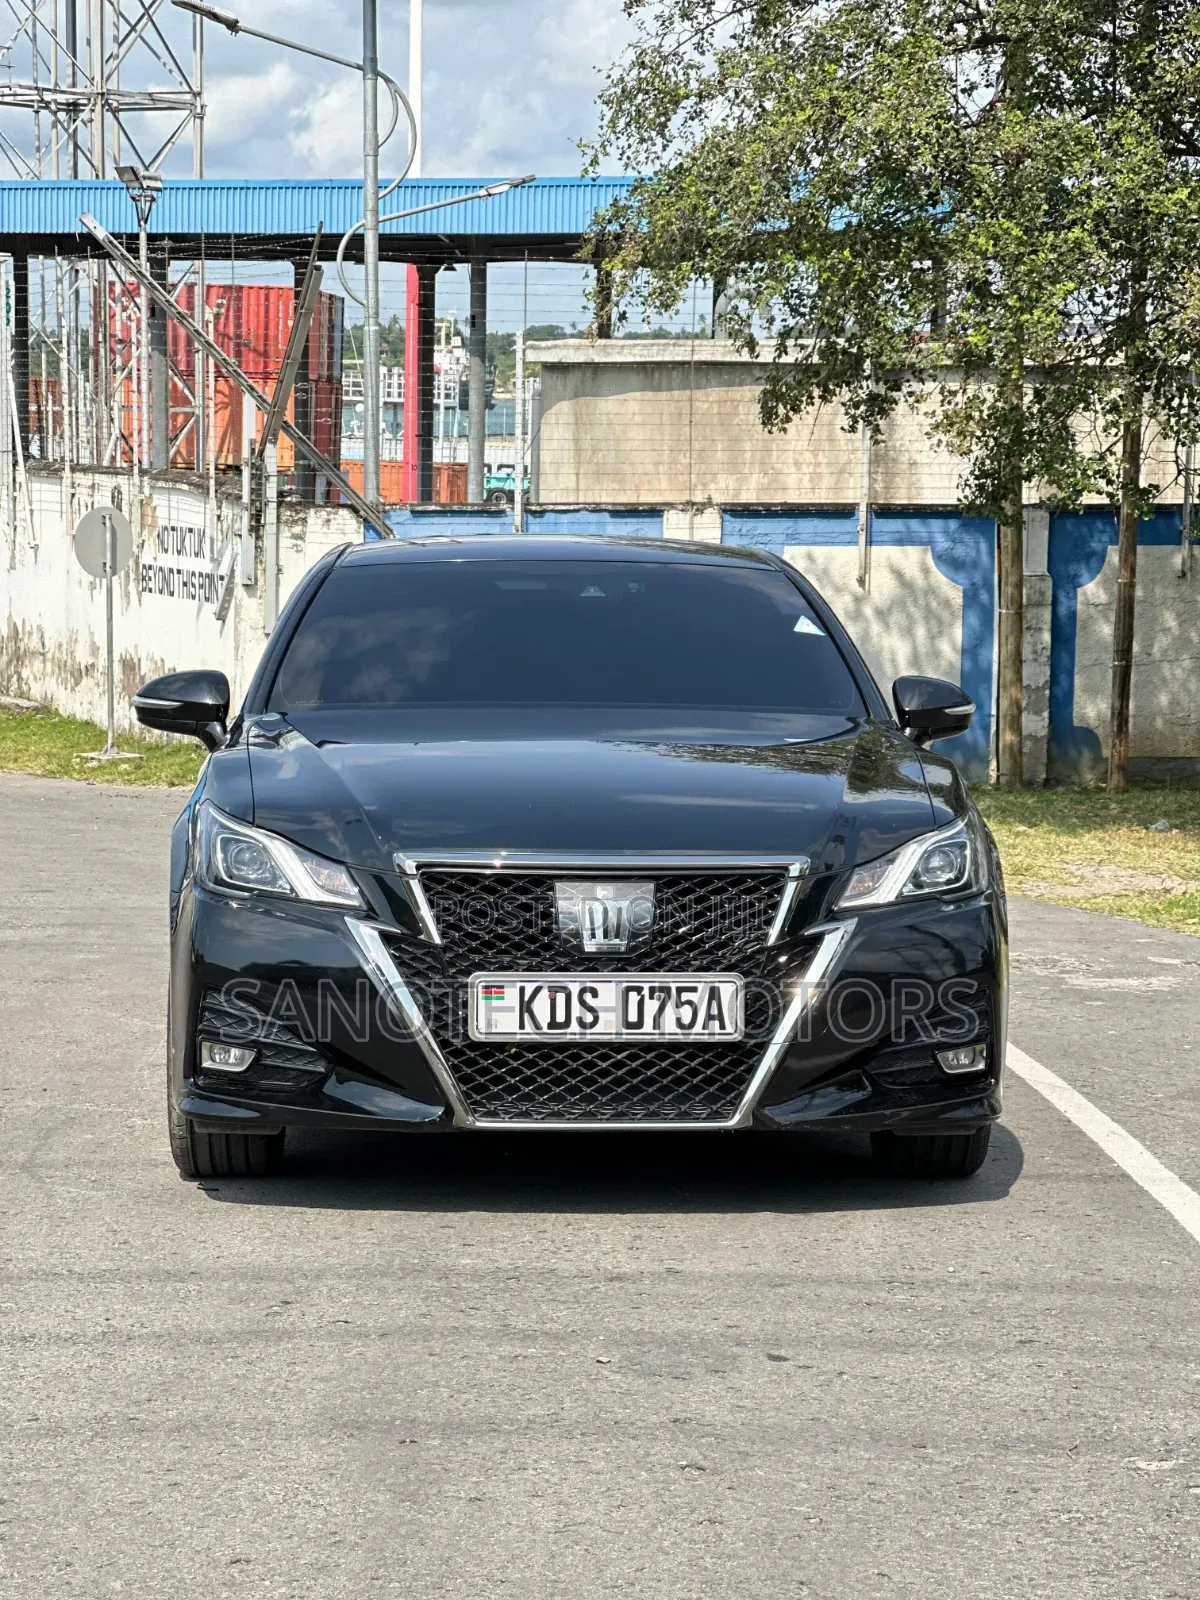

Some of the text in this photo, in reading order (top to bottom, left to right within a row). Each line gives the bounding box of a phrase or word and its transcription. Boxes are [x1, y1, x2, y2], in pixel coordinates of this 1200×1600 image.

[157, 524, 169, 554] NO
[142, 563, 175, 597] BEYOND
[176, 568, 196, 601] THIS
[518, 985, 600, 1031] KDS
[621, 985, 727, 1031] 075A
